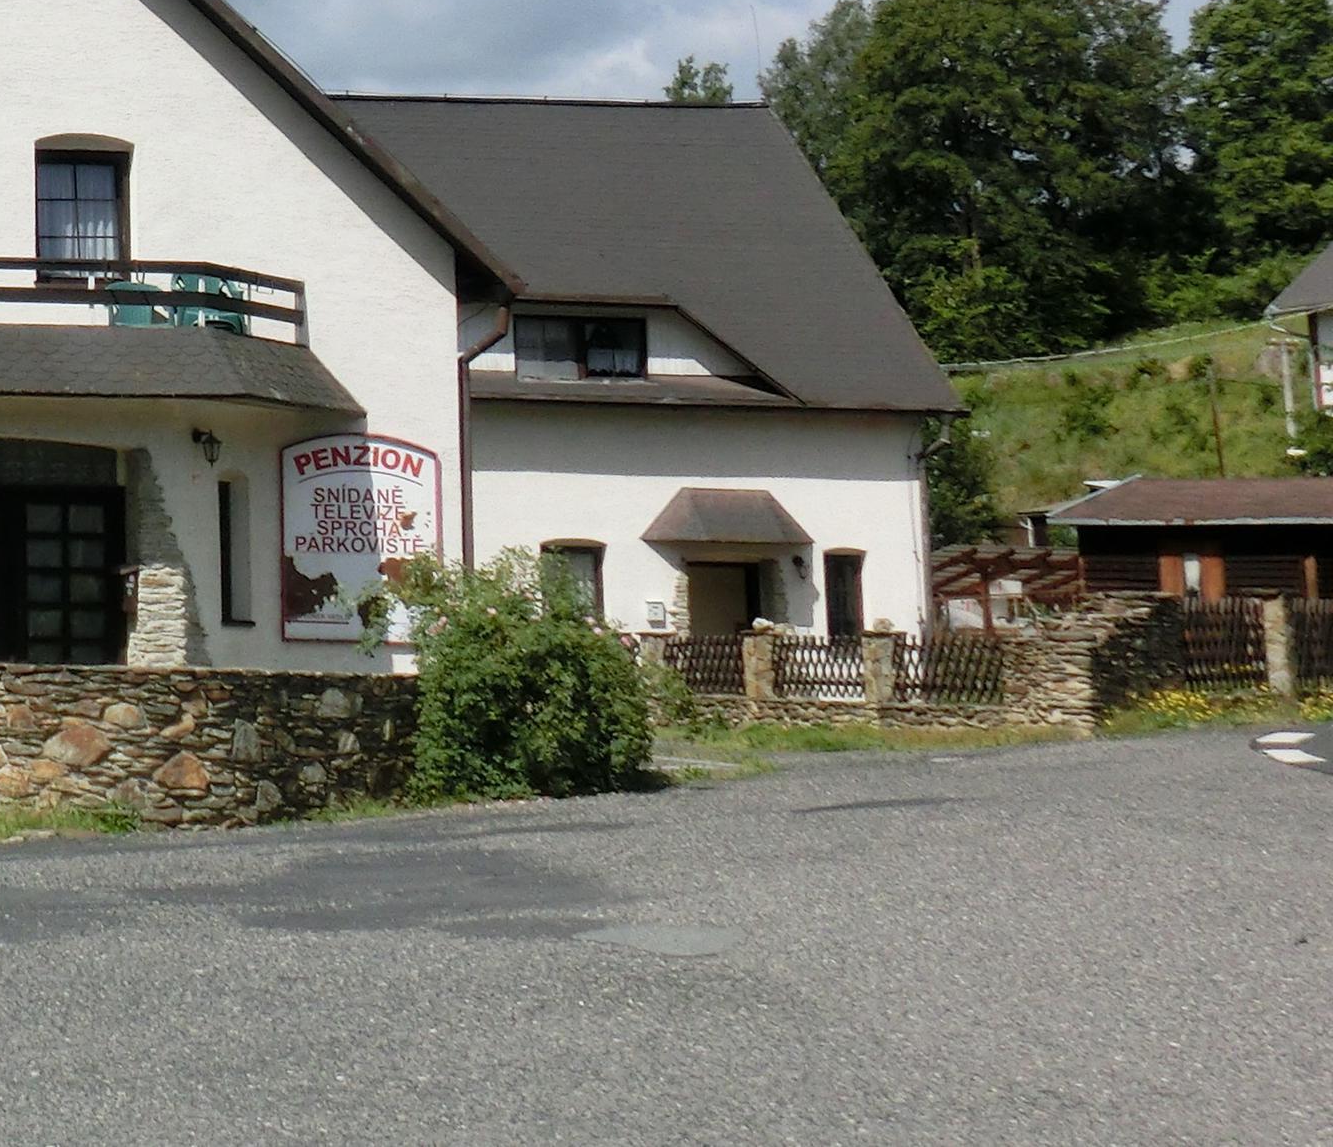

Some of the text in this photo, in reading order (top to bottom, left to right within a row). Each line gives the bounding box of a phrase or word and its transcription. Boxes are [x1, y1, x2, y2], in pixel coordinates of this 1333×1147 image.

[293, 444, 424, 478] PENZION
[313, 484, 403, 504] SNÍDANĚ
[310, 503, 406, 521] TELEVIZE
[317, 520, 402, 537] SPRCHA
